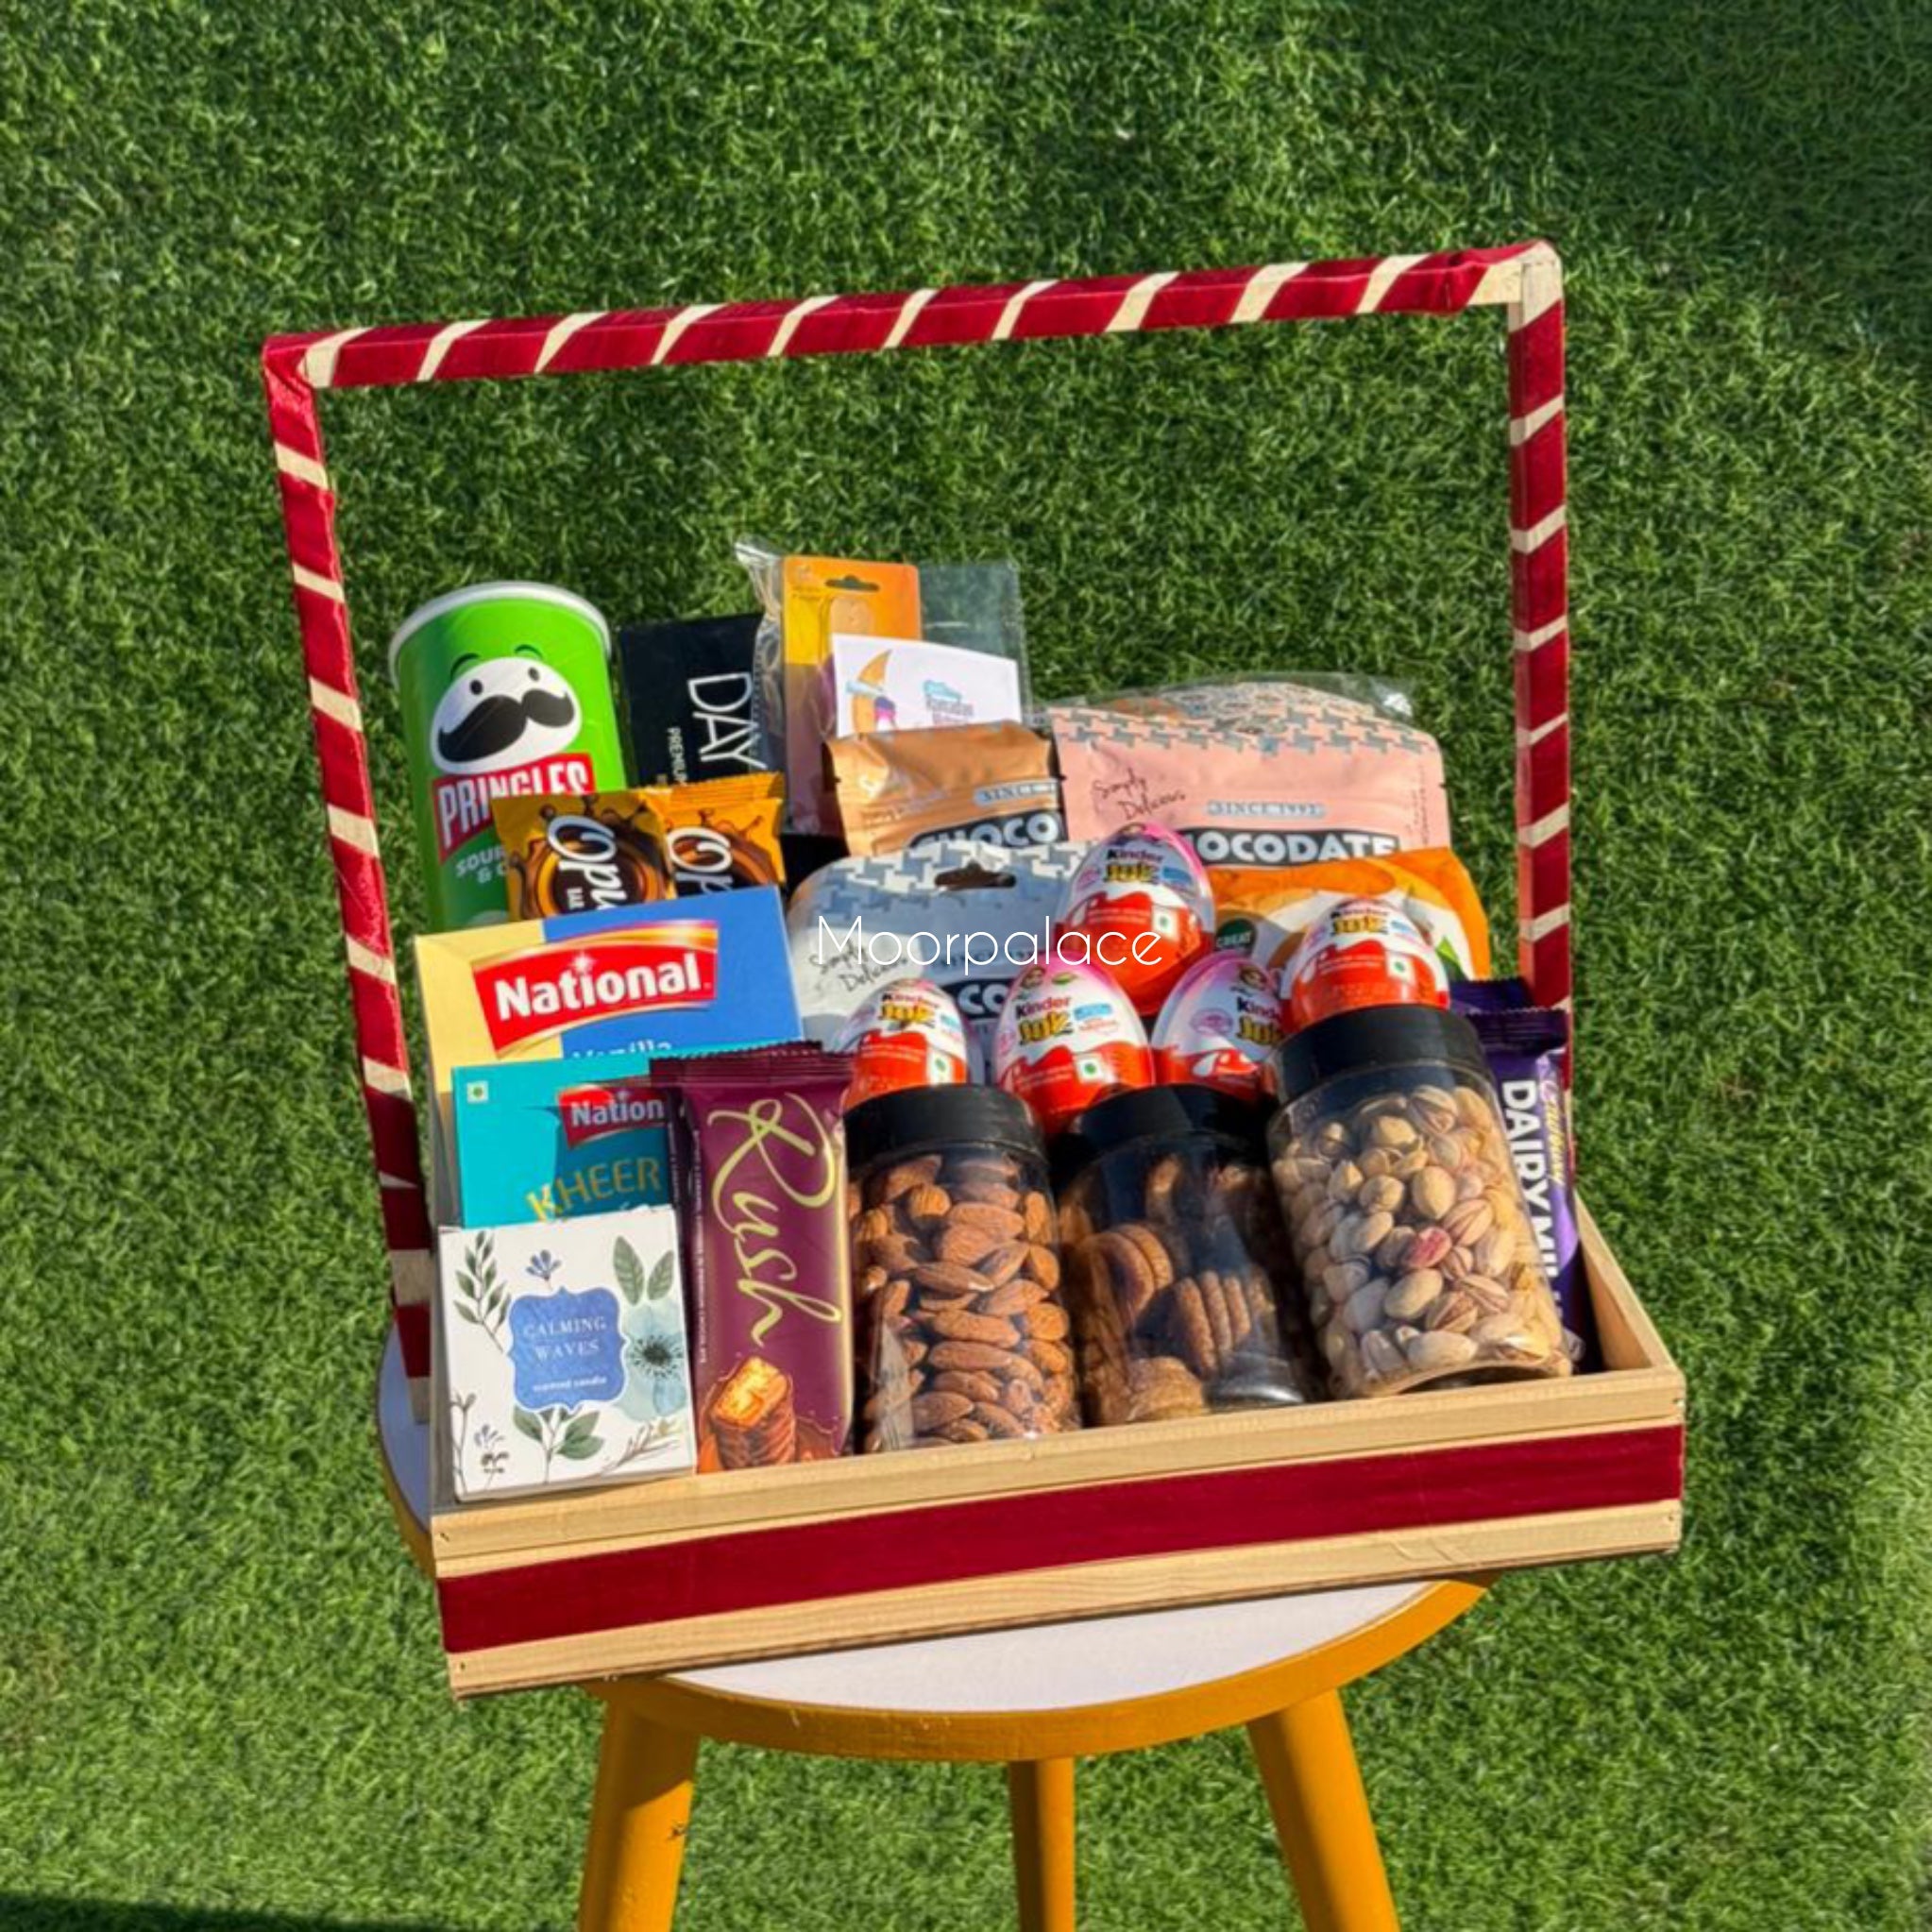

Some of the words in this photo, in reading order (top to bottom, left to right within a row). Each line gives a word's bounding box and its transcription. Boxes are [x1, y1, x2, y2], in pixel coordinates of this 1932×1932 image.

[687, 672, 768, 771] DAY
[493, 949, 702, 1023] National
[1015, 995, 1072, 1019] Kinder
[569, 1090, 665, 1127] Nation
[1501, 1079, 1551, 1212] DAIRY
[525, 1156, 662, 1223] KHEER
[706, 1092, 842, 1348] Rush
[522, 1315, 607, 1339] CALMING
[534, 1339, 600, 1362] WAVES
